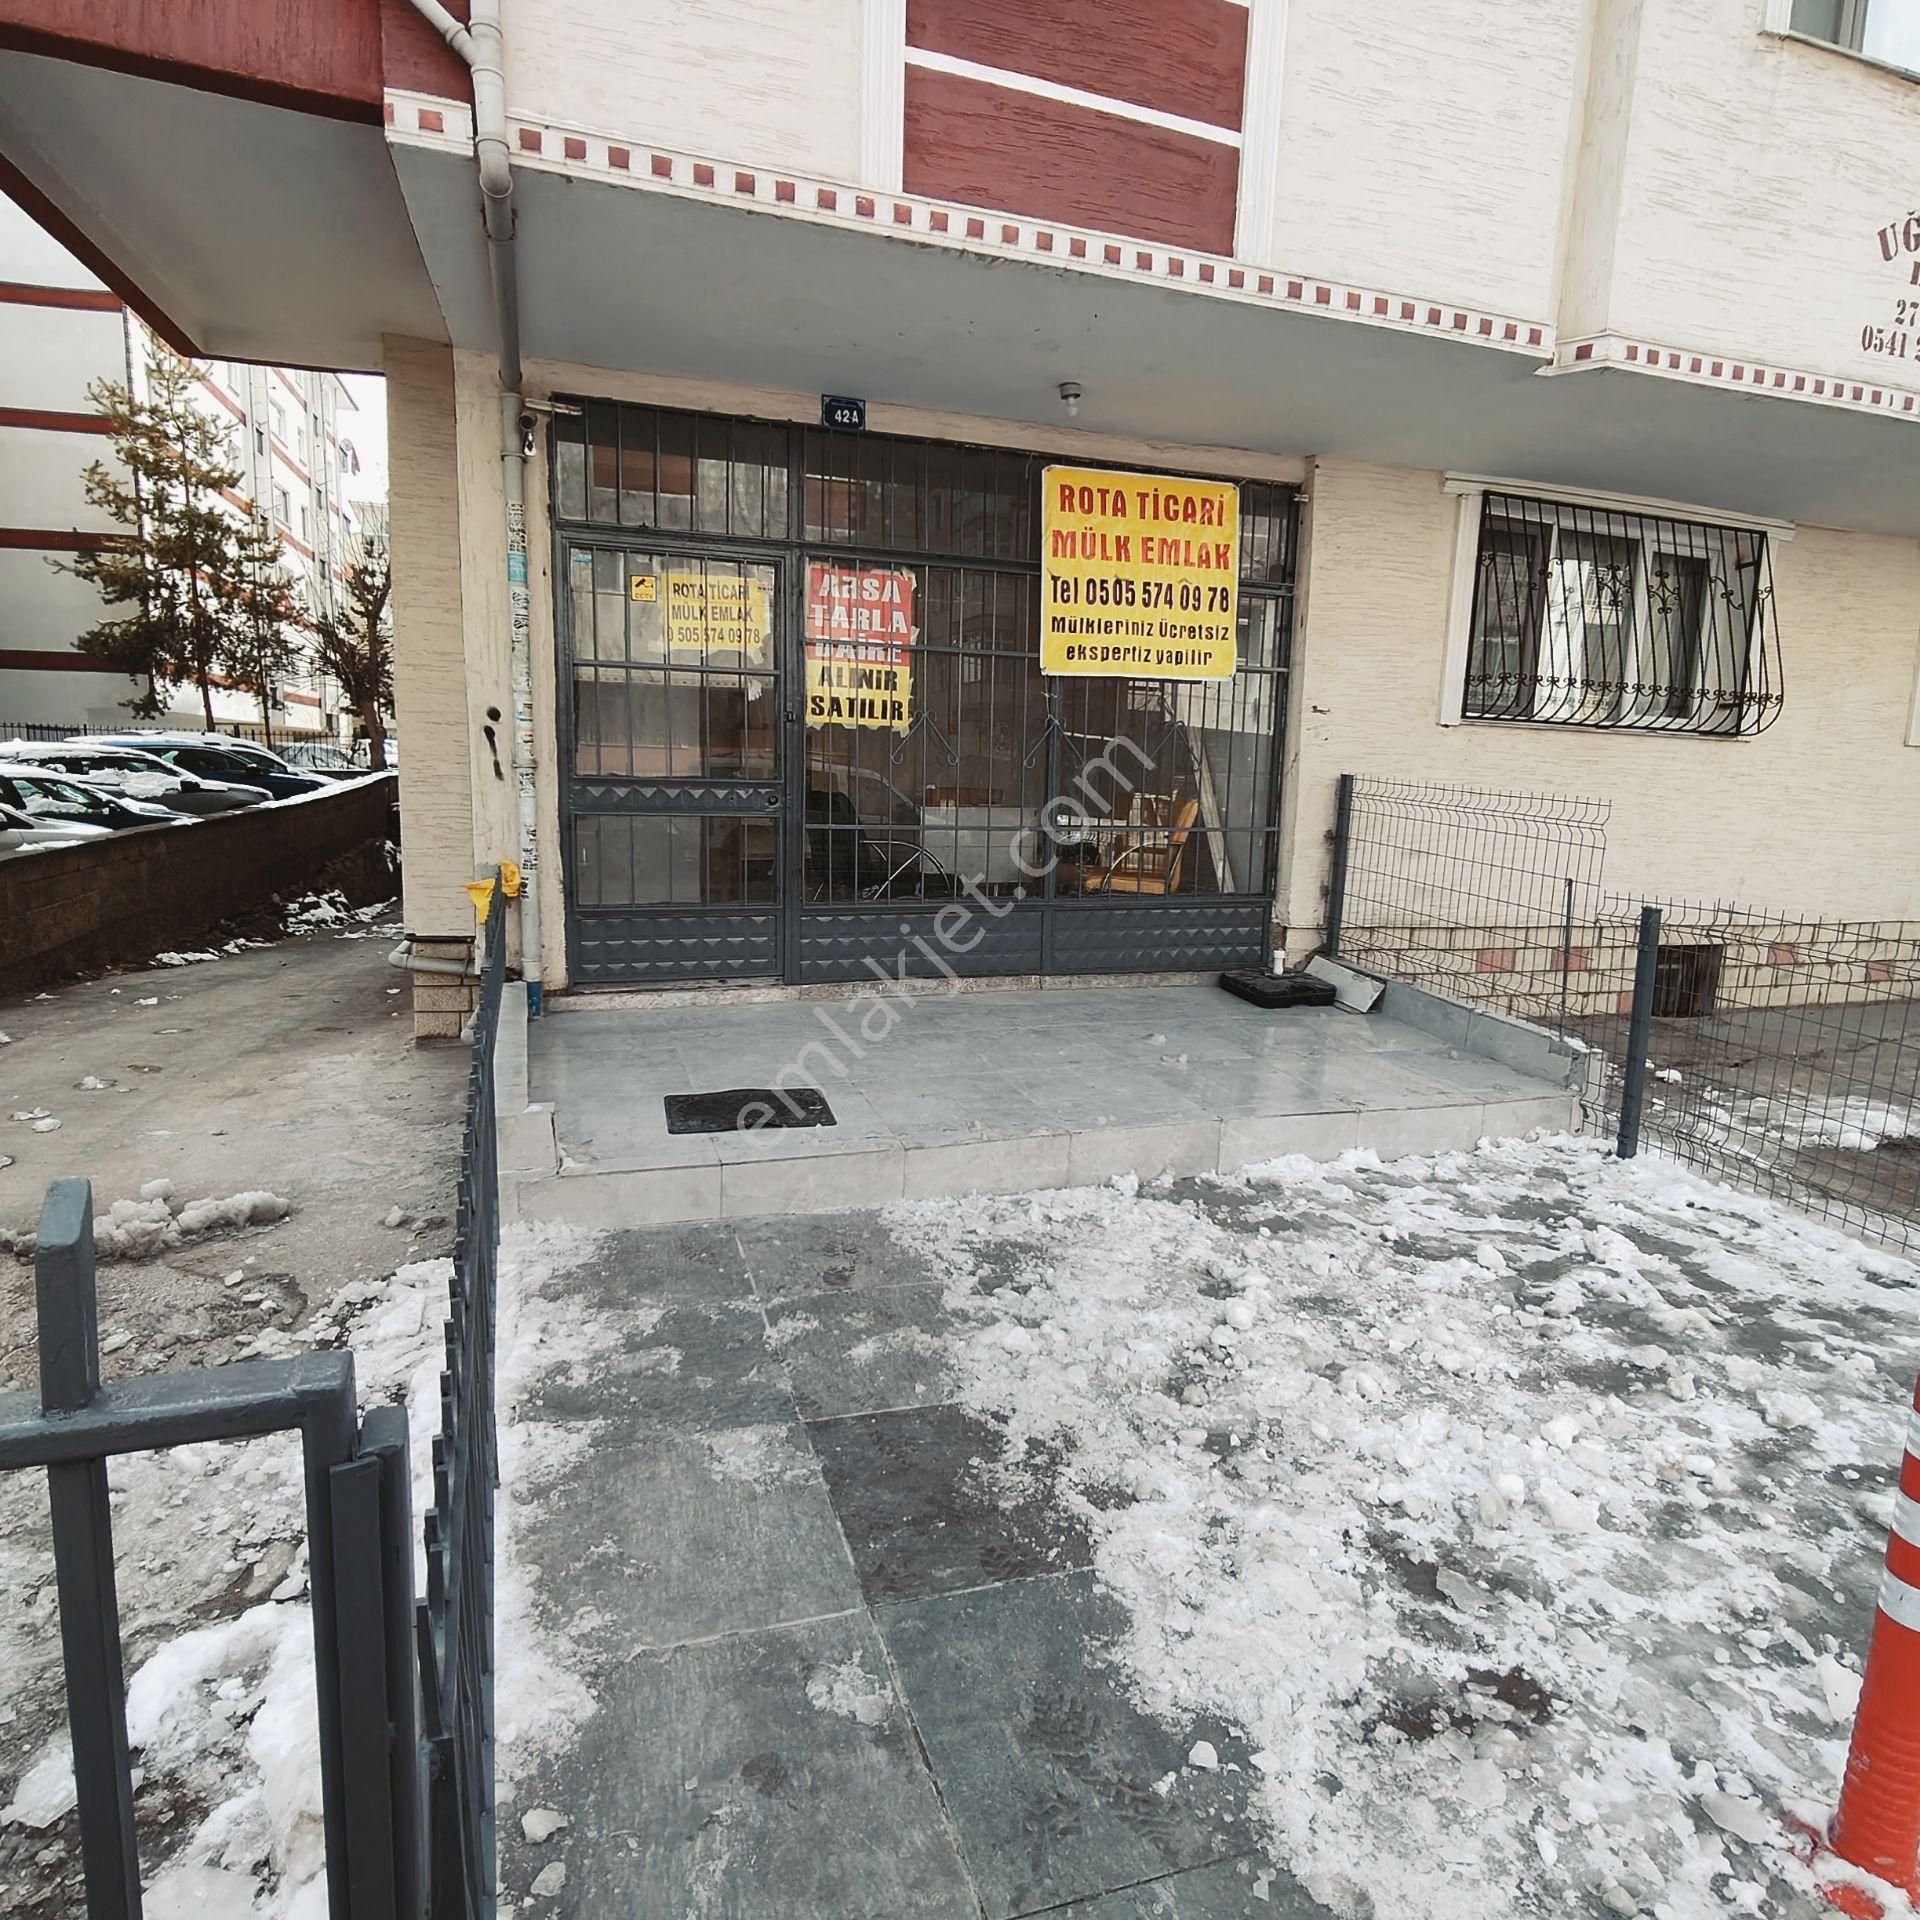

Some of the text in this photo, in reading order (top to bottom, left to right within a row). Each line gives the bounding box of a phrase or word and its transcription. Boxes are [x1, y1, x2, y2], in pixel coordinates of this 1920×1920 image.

[1861, 325, 1907, 358] 0541
[1059, 484, 1225, 527] ROTA TİCARİ
[1052, 527, 1230, 570] MÜLK EMLAK
[672, 582, 705, 599] ROTA
[1051, 575, 1230, 613] Tel 0505 574 09 78
[671, 602, 754, 623] MÜLK EMLAK
[811, 604, 908, 634] TARLA
[678, 626, 700, 642] 505
[728, 628, 742, 644] 09
[745, 629, 760, 644] 78
[1051, 616, 1154, 637] Mülkleriniz
[1066, 644, 1151, 663] ekspertiz
[810, 695, 904, 721] SATILIR
